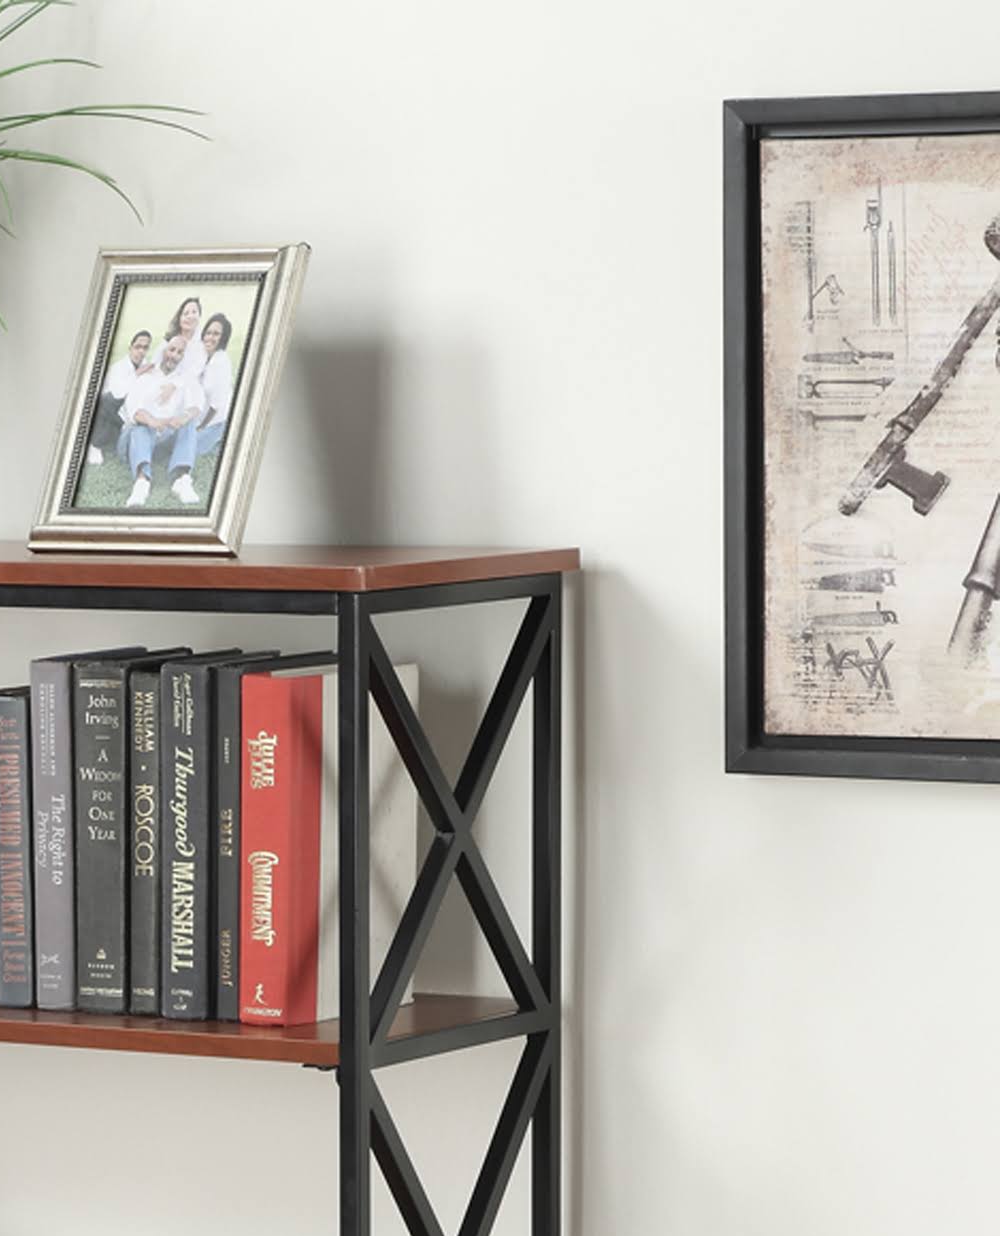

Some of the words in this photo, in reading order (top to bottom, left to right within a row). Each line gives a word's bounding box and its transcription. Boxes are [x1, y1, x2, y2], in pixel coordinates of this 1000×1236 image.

[85, 712, 119, 728] Irving
[88, 694, 116, 708] John
[135, 691, 144, 752] KENNEDY
[144, 691, 155, 751] WILLIAM
[98, 749, 108, 762] A
[51, 794, 66, 823] The
[169, 746, 195, 857] Thurgood
[37, 811, 49, 867] Privacy
[48, 826, 66, 866] Right
[135, 784, 155, 876] ROSCOE
[220, 809, 233, 857] FIRE
[0, 852, 25, 935] INNOCENT
[51, 870, 63, 885] to
[170, 861, 195, 973] MARSHALL
[220, 929, 233, 987] JUNGER
